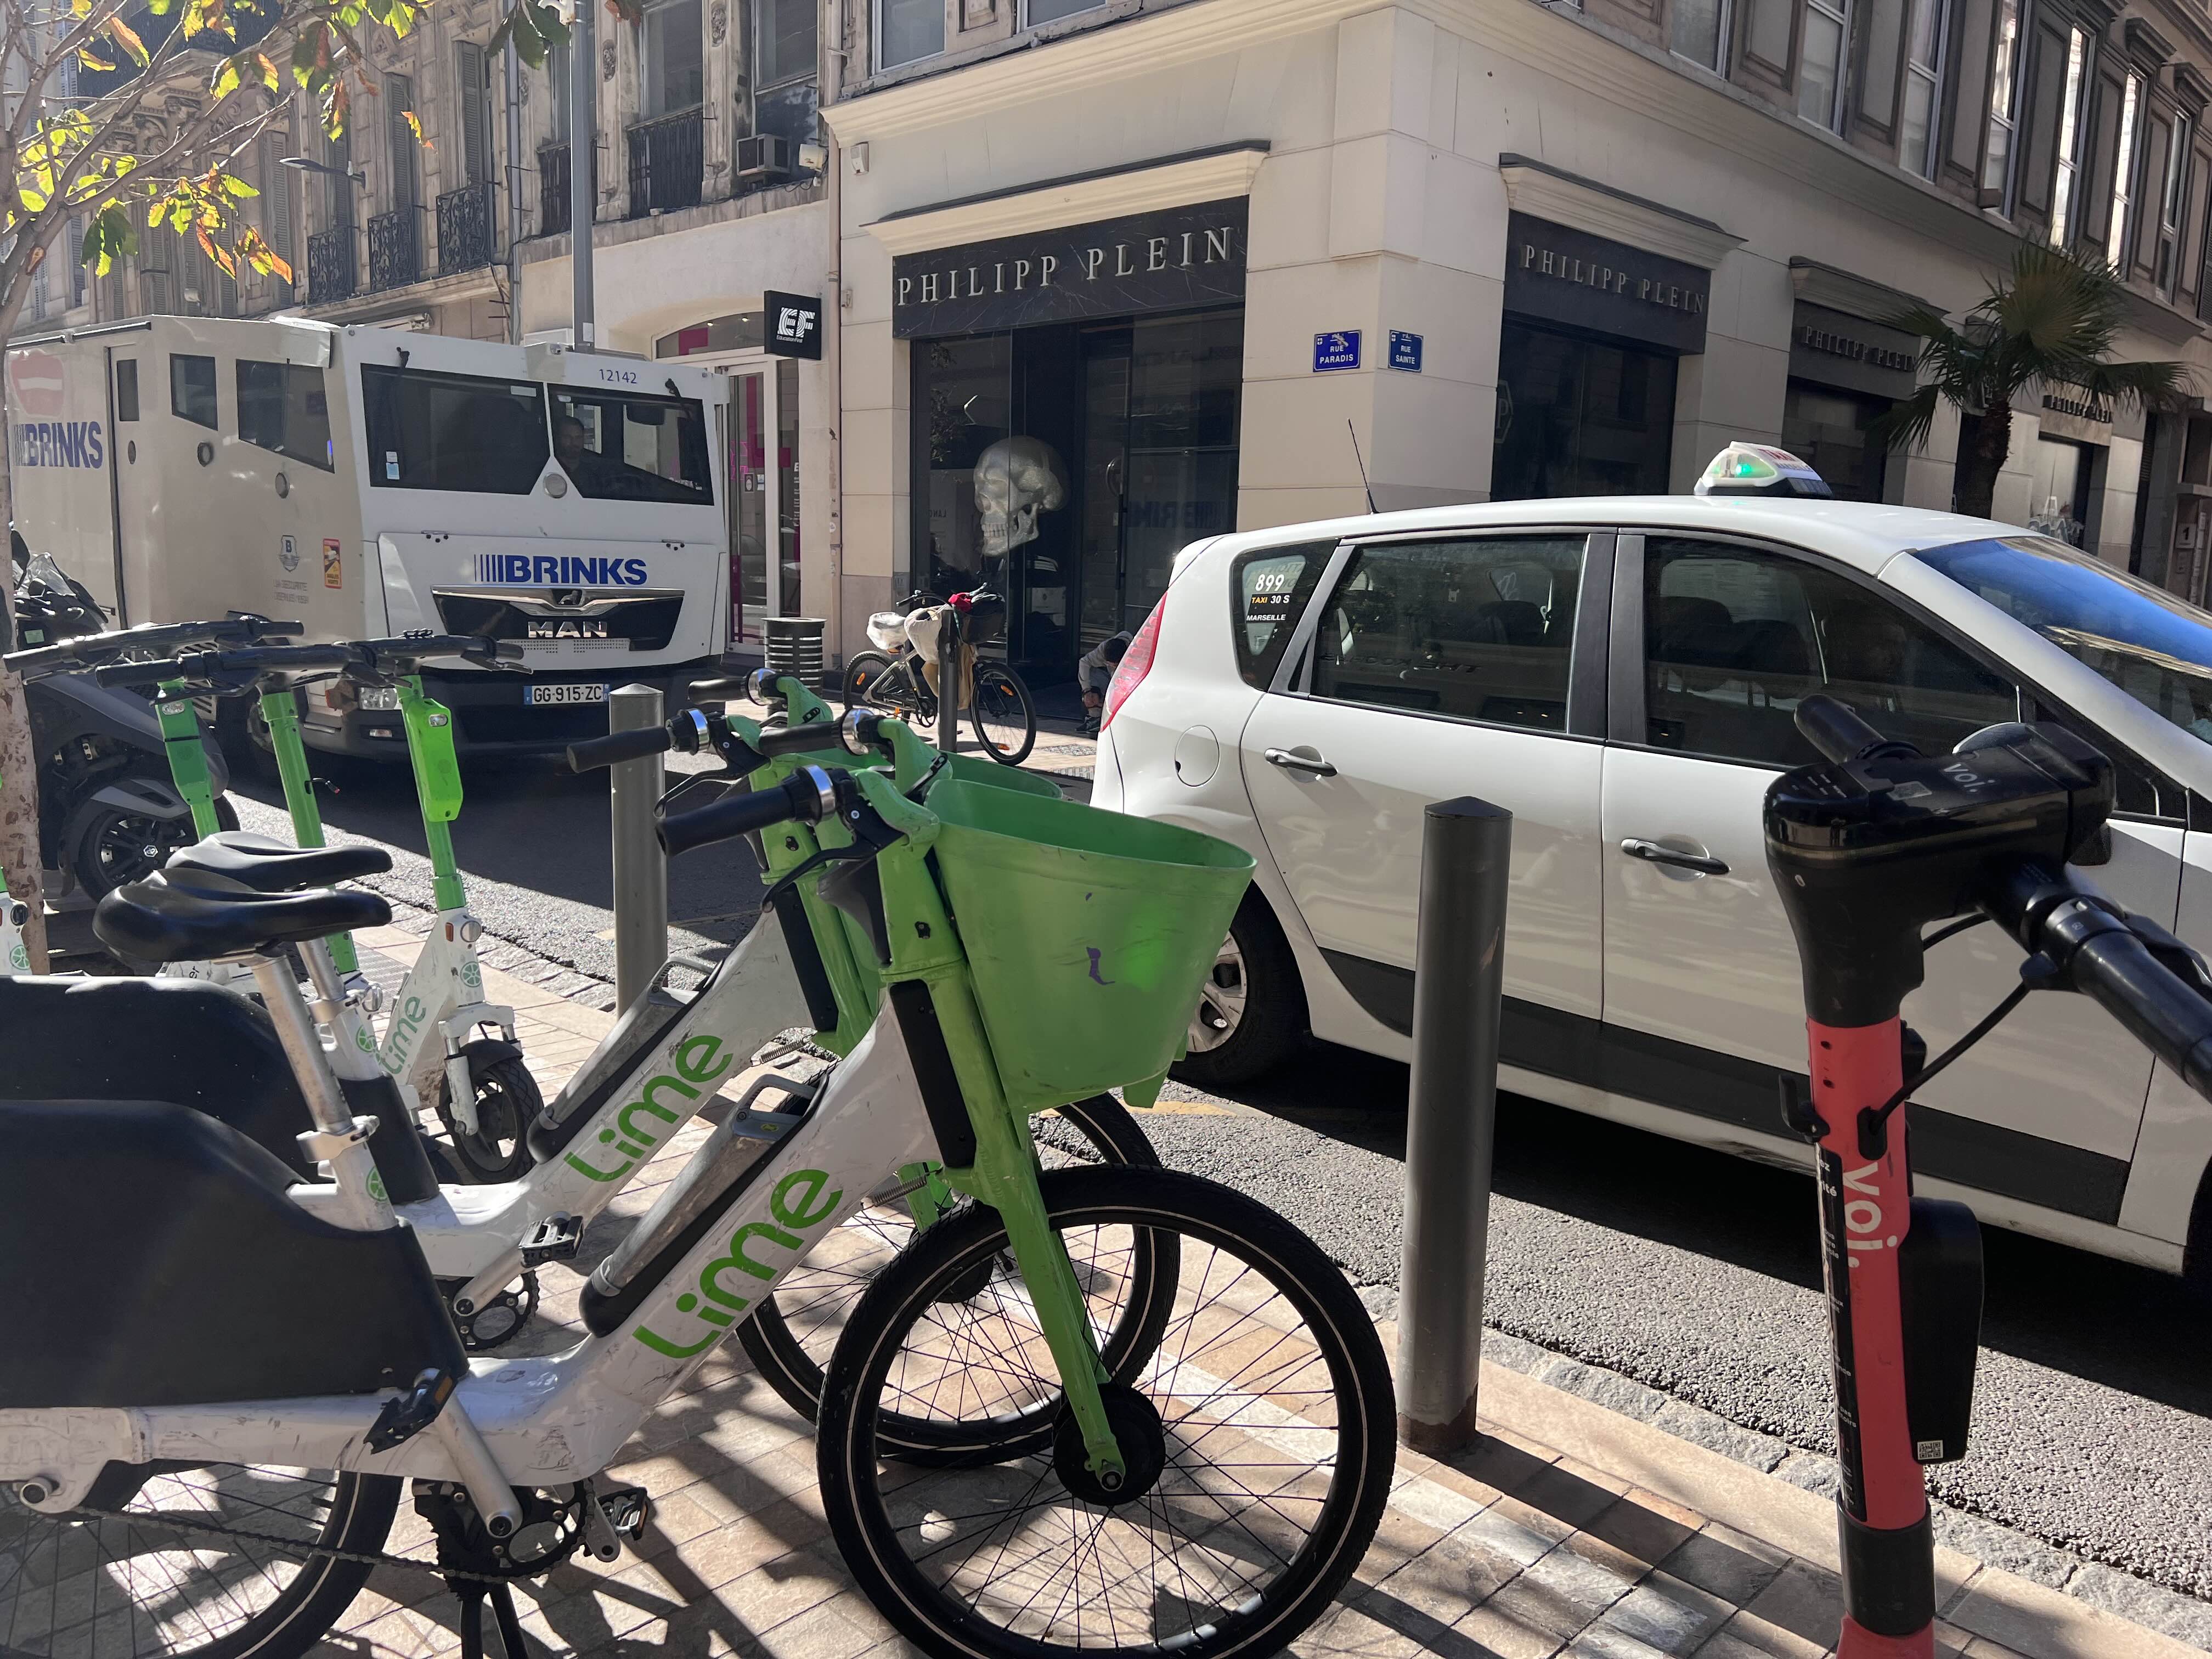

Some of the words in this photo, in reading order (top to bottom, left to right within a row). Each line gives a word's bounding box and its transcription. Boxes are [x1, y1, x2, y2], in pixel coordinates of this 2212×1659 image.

[898, 255, 1057, 306] PHILIPP
[1086, 226, 1231, 280] PLEIN
[1525, 244, 1626, 294] PHILIPP
[1642, 278, 1705, 313] PLEIN
[777, 307, 815, 338] EF
[1804, 326, 1870, 360] PHILIPP
[1319, 354, 1354, 364] PARADIS
[1395, 355, 1415, 365] SAINTE
[599, 369, 637, 384] 12142
[23, 421, 103, 469] BRINKS
[285, 540, 292, 553] B
[505, 555, 647, 585] BRINKS
[1255, 574, 1285, 592] 899
[1270, 595, 1282, 604] 30
[1283, 595, 1290, 603] S
[527, 621, 608, 638] MAN
[534, 686, 602, 703] GG-915-ZC
[1943, 763, 1995, 793] voi.
[381, 996, 426, 1075] Lime
[563, 1035, 733, 1183] Lime
[1842, 1161, 1898, 1268] voi.
[631, 1169, 844, 1359] Lime
